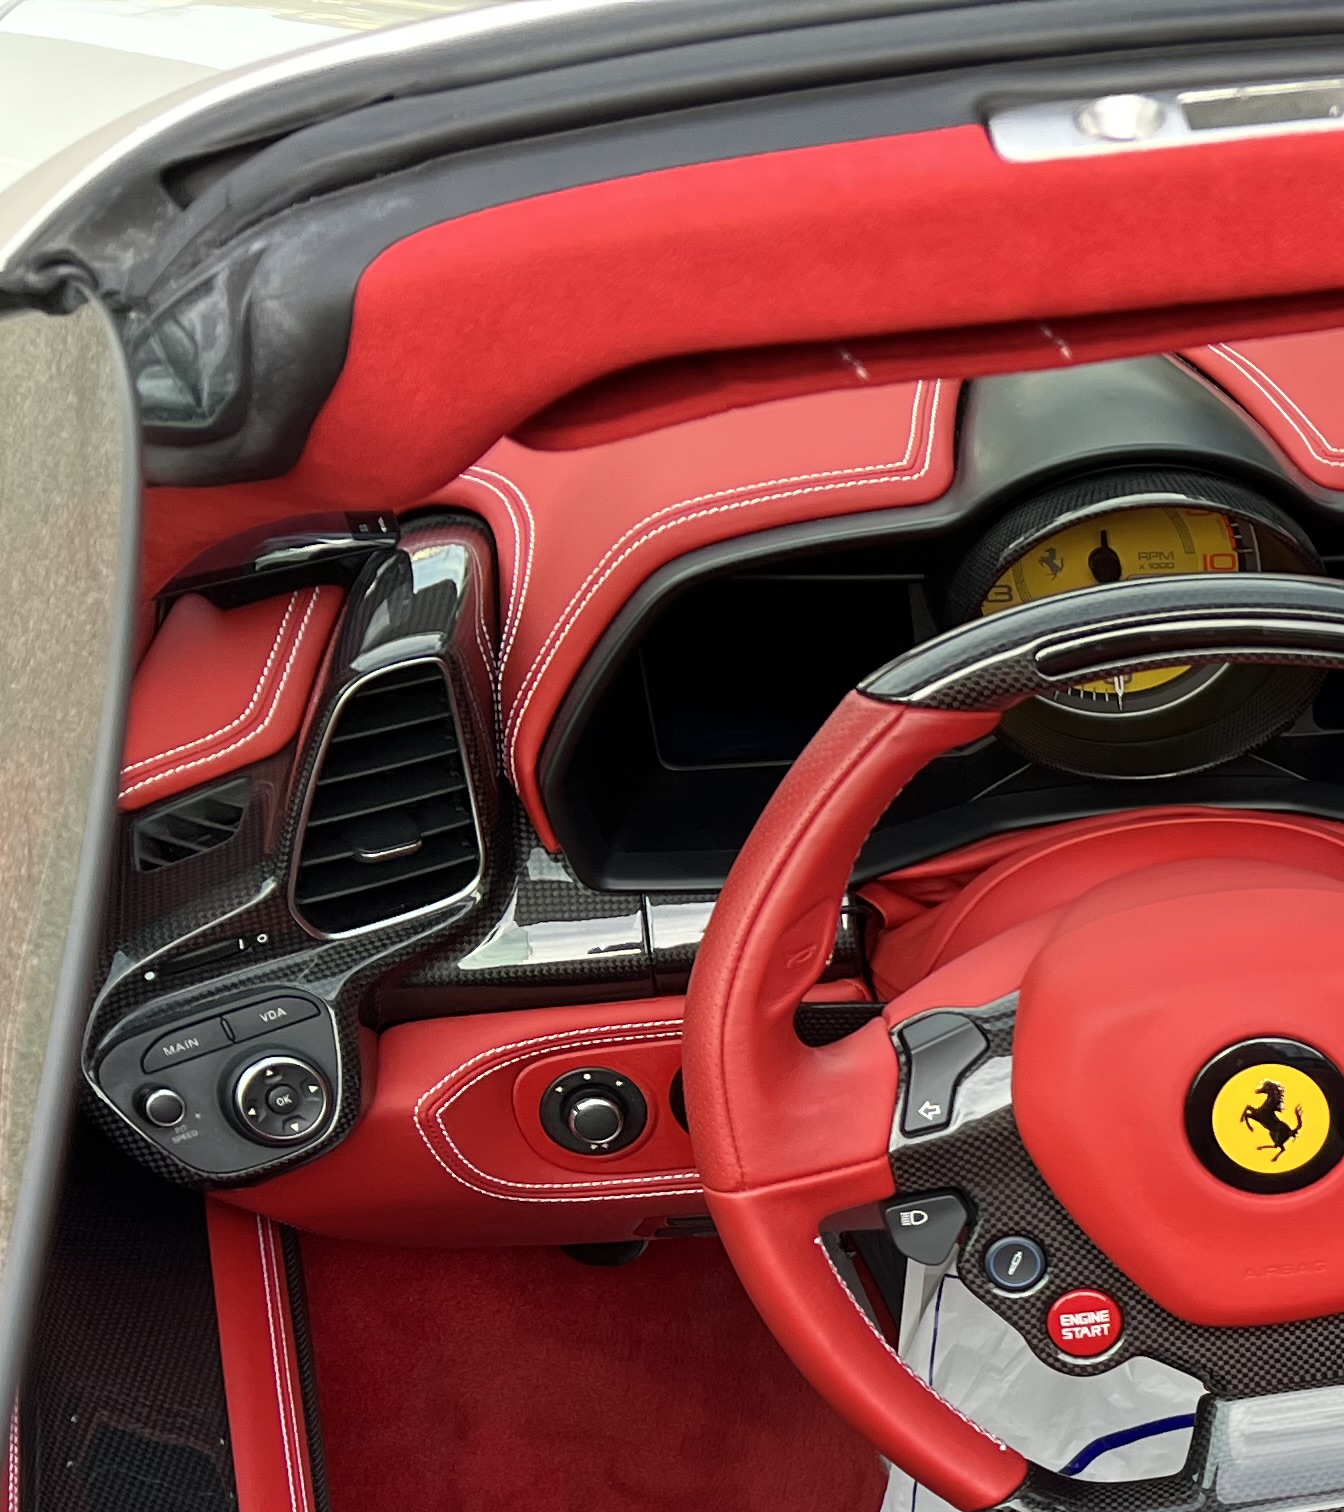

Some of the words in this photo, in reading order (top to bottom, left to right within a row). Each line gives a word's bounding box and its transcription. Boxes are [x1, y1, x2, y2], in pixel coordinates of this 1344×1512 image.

[1138, 551, 1175, 561] RPM
[1203, 553, 1238, 572] 10
[1148, 560, 1175, 570] 1000
[259, 1007, 287, 1022] VDA
[162, 1038, 199, 1056] MAIN
[276, 1094, 292, 1107] OK
[171, 1129, 199, 1145] SPEED
[1243, 1260, 1328, 1280] AIRBAG
[1059, 1309, 1110, 1328] ENGINE
[1061, 1323, 1111, 1341] START
